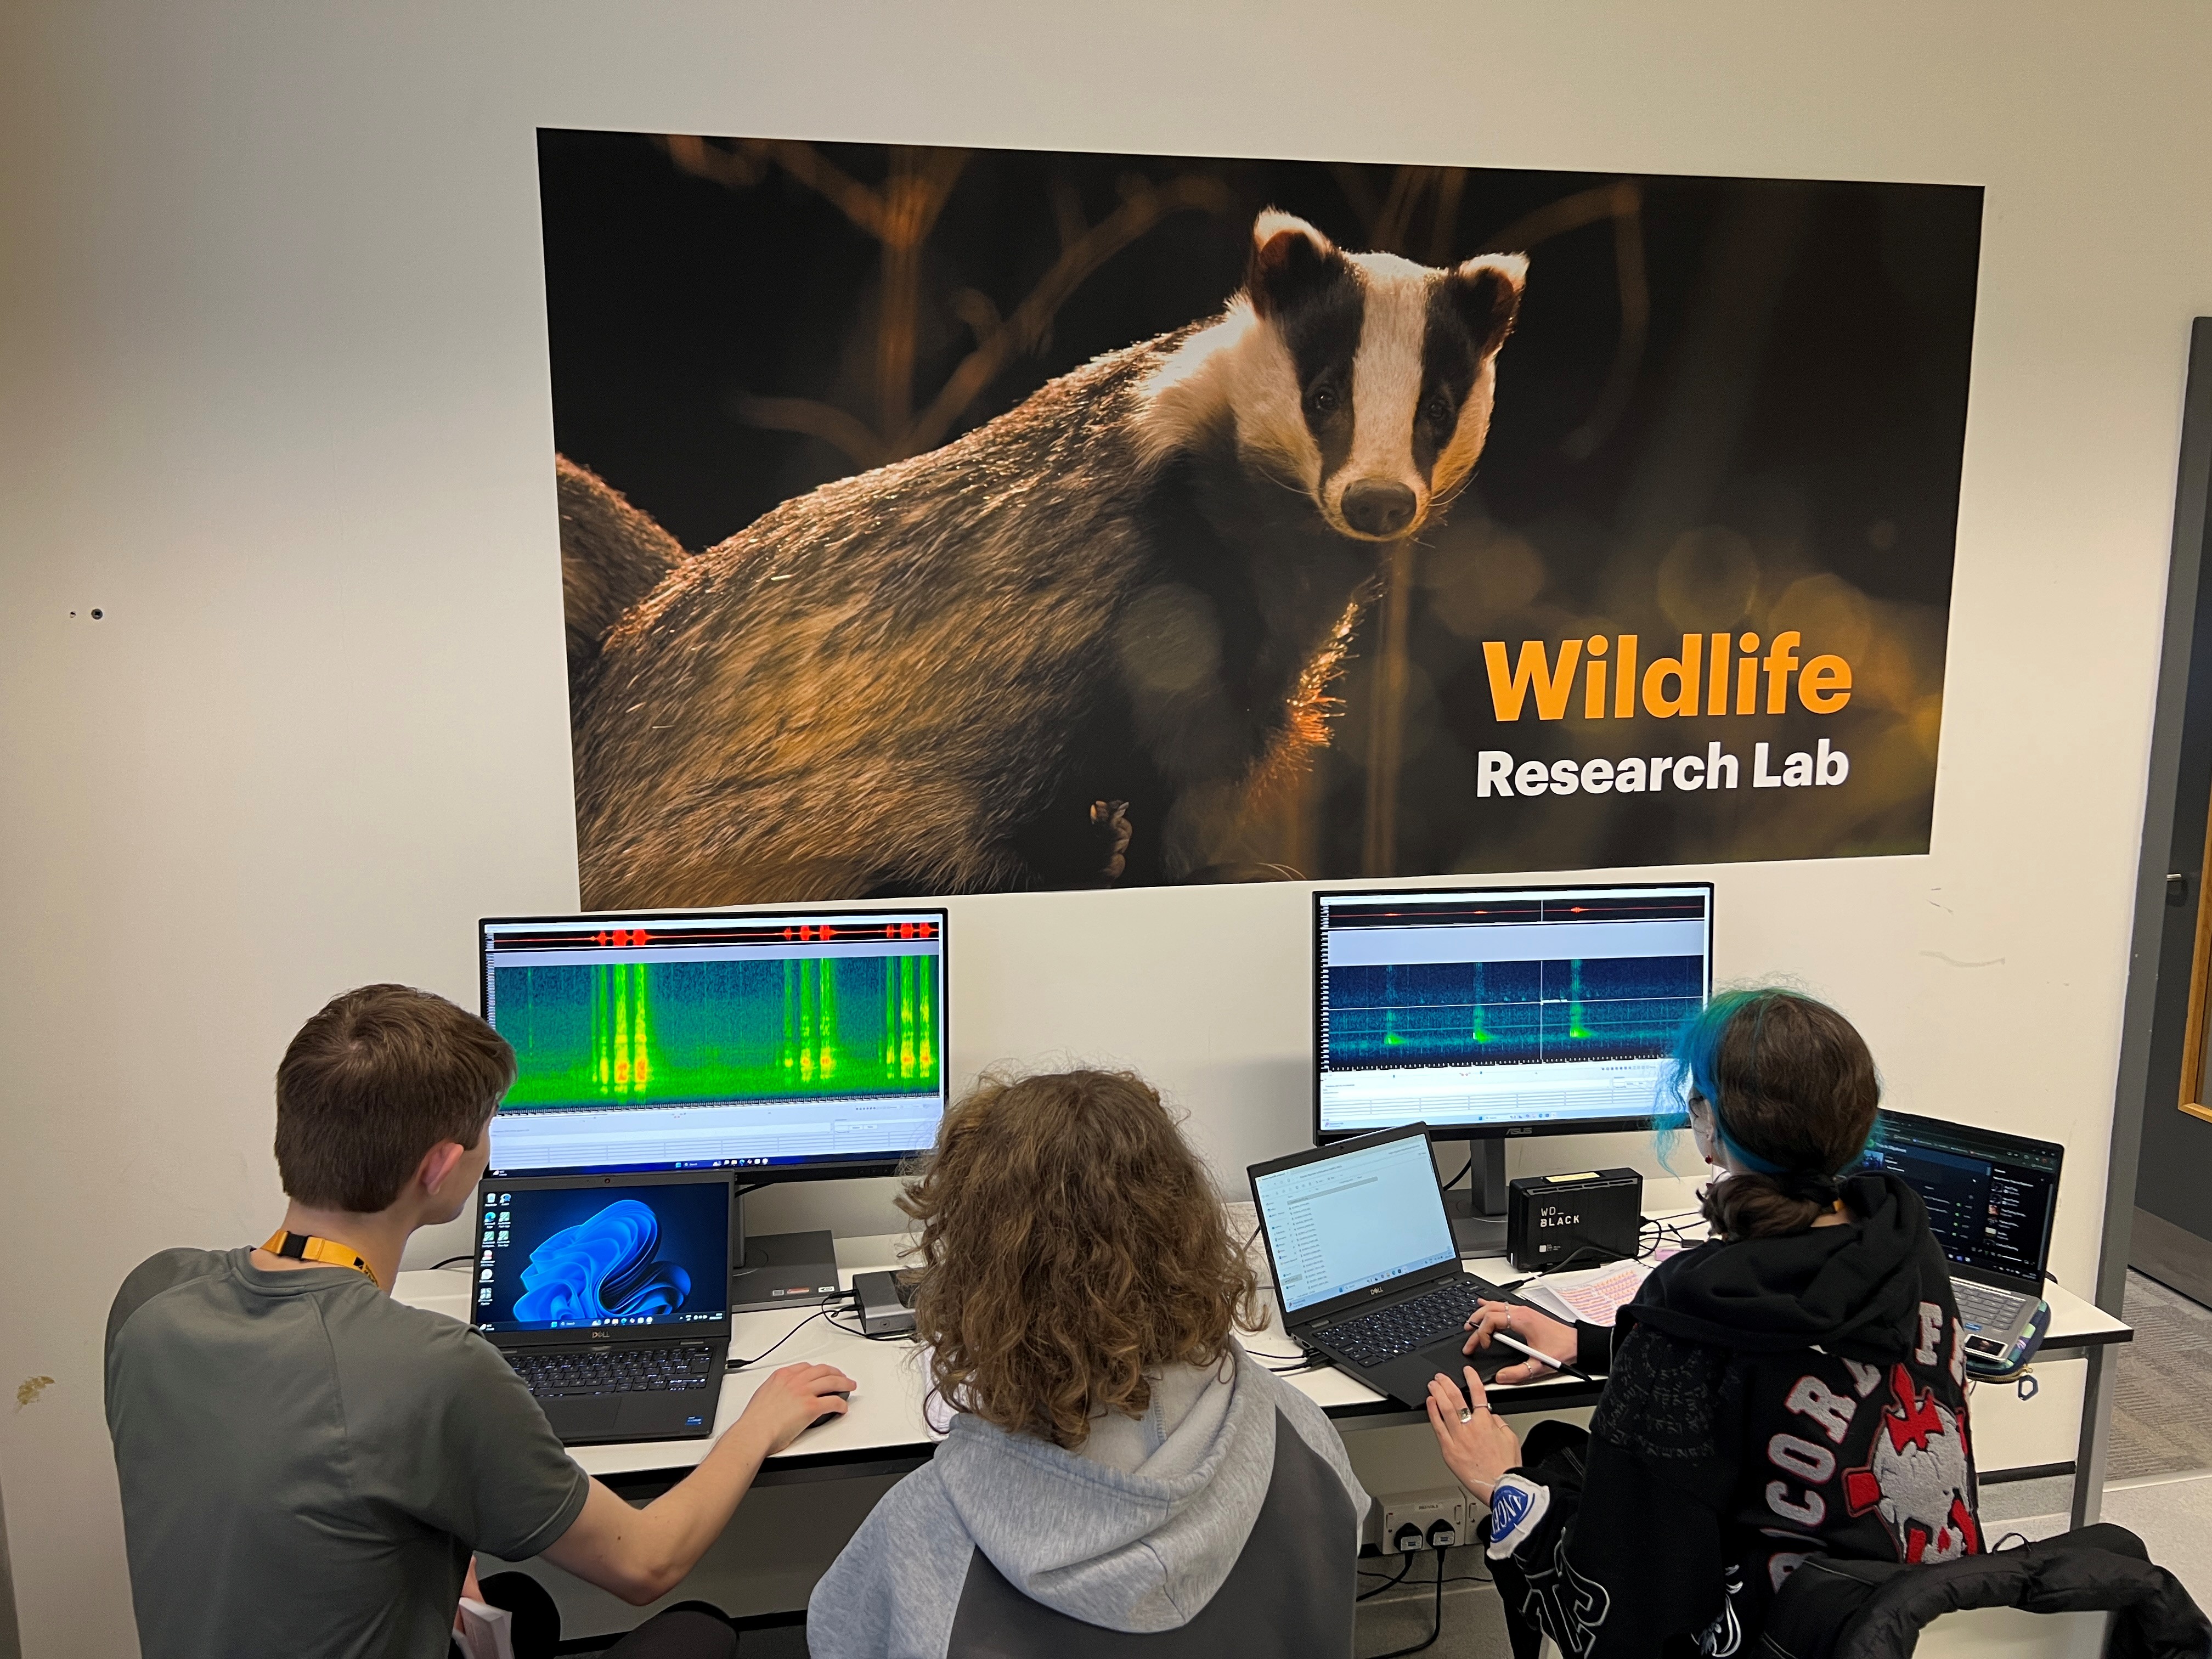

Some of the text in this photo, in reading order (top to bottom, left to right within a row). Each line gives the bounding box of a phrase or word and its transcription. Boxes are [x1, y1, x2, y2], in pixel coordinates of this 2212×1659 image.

[1482, 631, 1853, 722] Wildlife
[1476, 737, 1849, 798] Research Lab
[1540, 1215, 1579, 1227] BLACK
[1370, 1286, 1384, 1295] DELL
